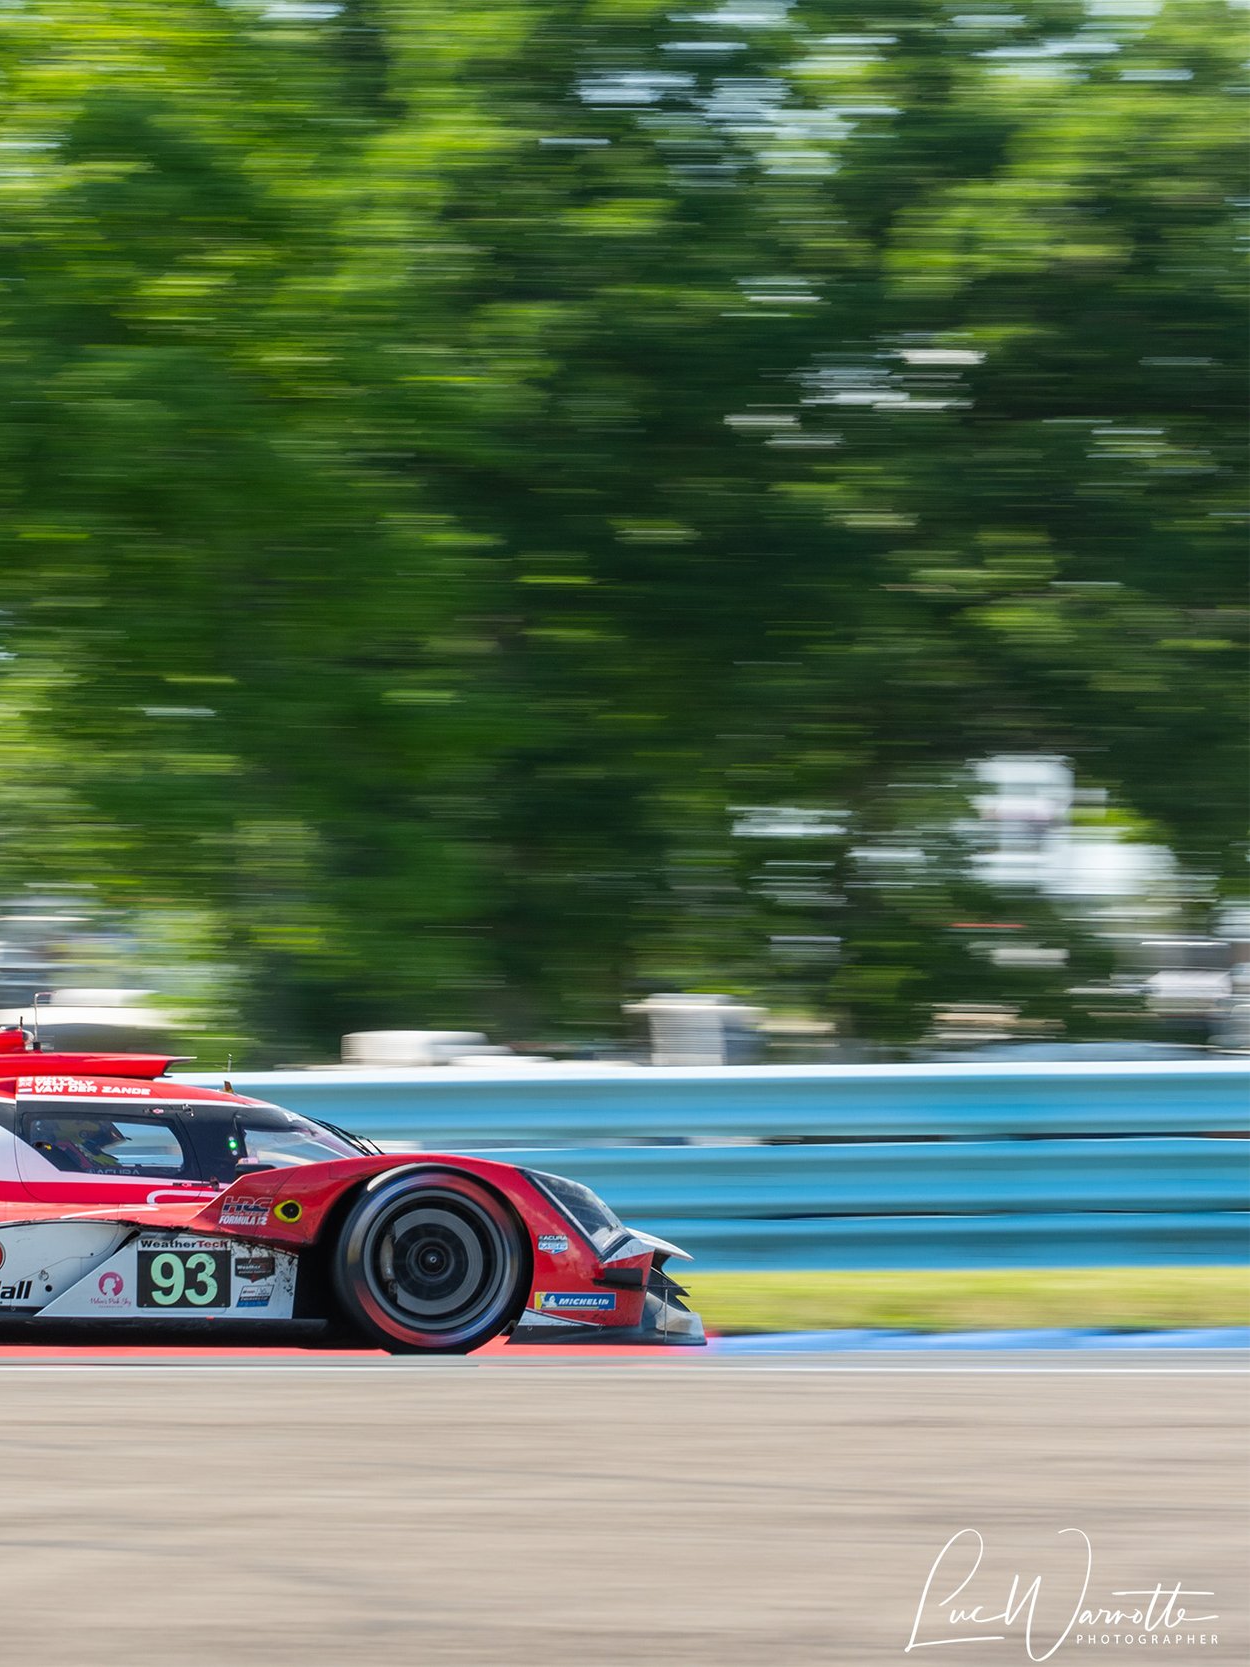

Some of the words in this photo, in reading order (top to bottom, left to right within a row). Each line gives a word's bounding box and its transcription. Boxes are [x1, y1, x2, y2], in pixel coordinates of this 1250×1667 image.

[35, 1085, 63, 1093] VAN
[68, 1085, 97, 1093] DER
[102, 1086, 151, 1095] ZANDE
[222, 1196, 273, 1213] HRC
[219, 1216, 255, 1225] FORMULA
[141, 1240, 228, 1249] WeatherTech
[151, 1253, 219, 1306] 93
